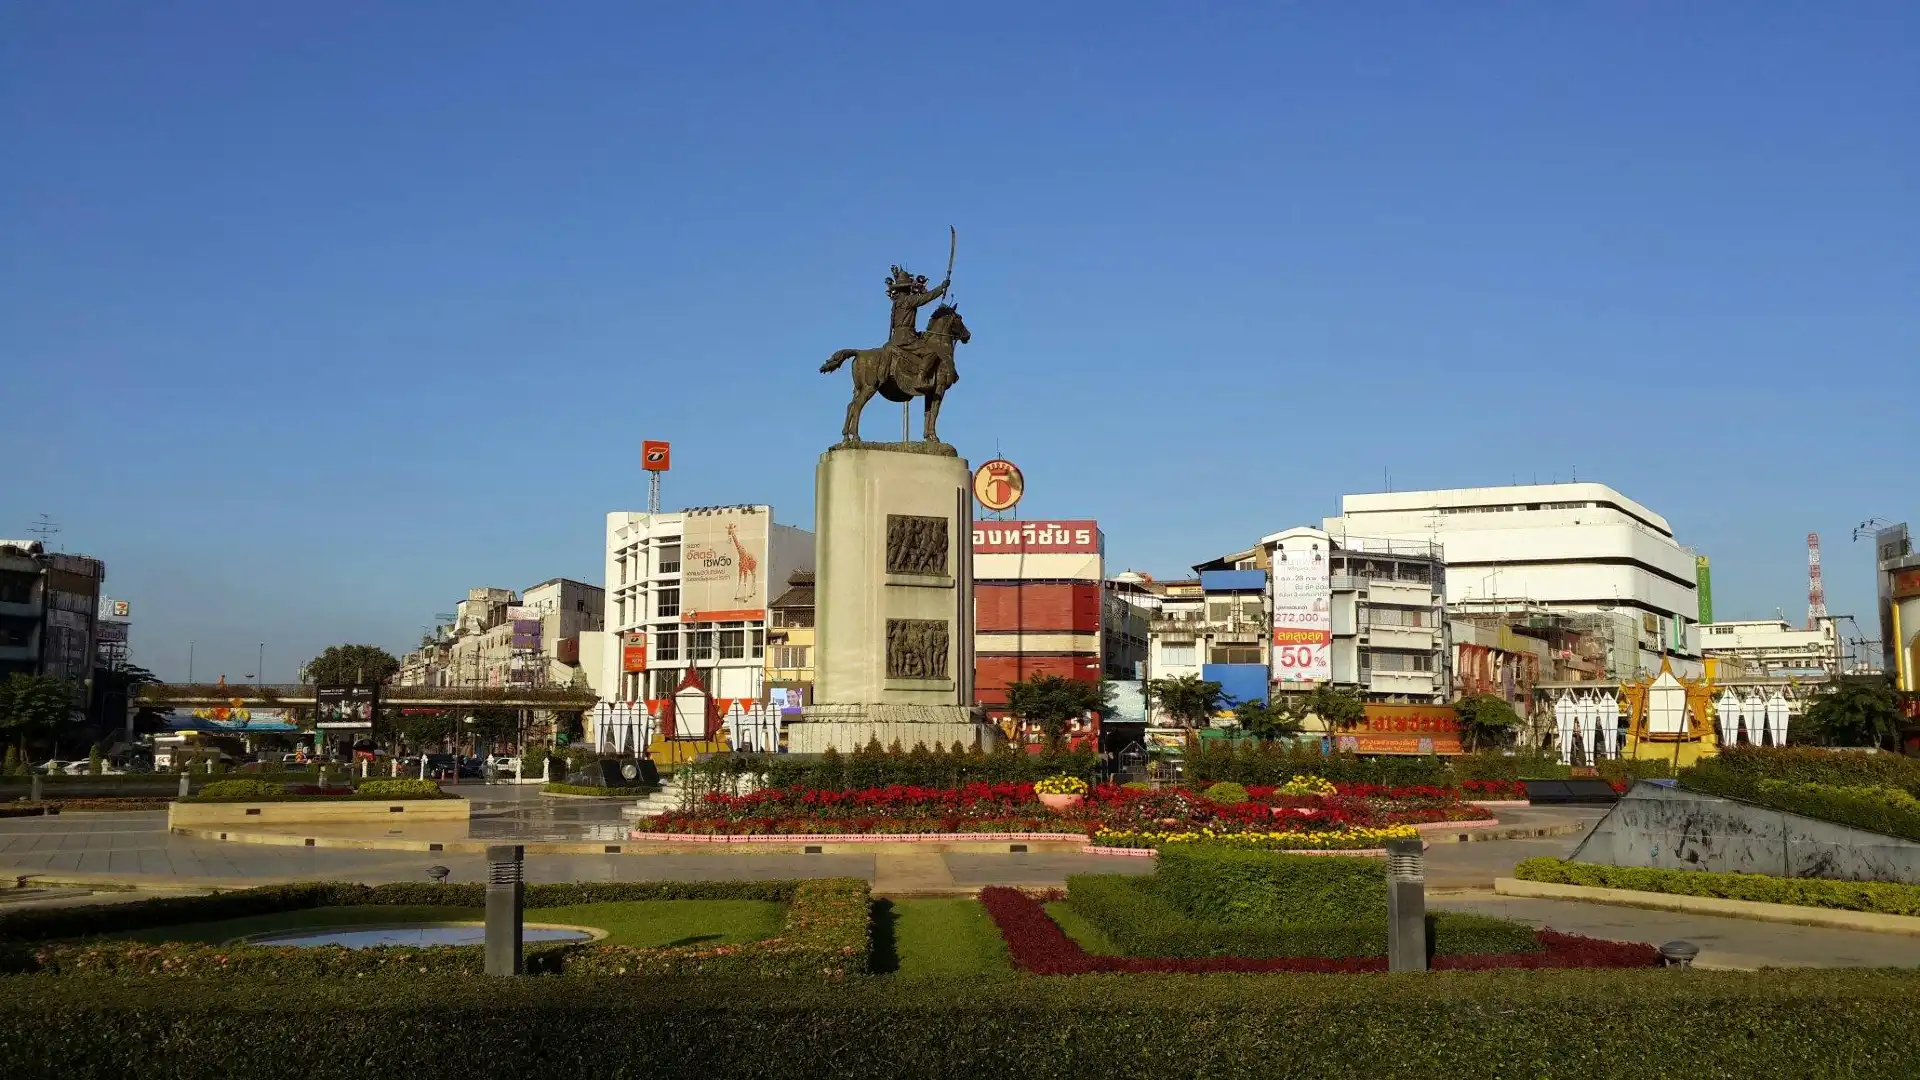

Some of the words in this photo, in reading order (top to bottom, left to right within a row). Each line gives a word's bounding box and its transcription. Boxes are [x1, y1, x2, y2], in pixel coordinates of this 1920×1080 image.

[1075, 529, 1091, 545] 5
[1275, 613, 1319, 623] 272,000
[1277, 630, 1324, 644] ลดสูงสุด
